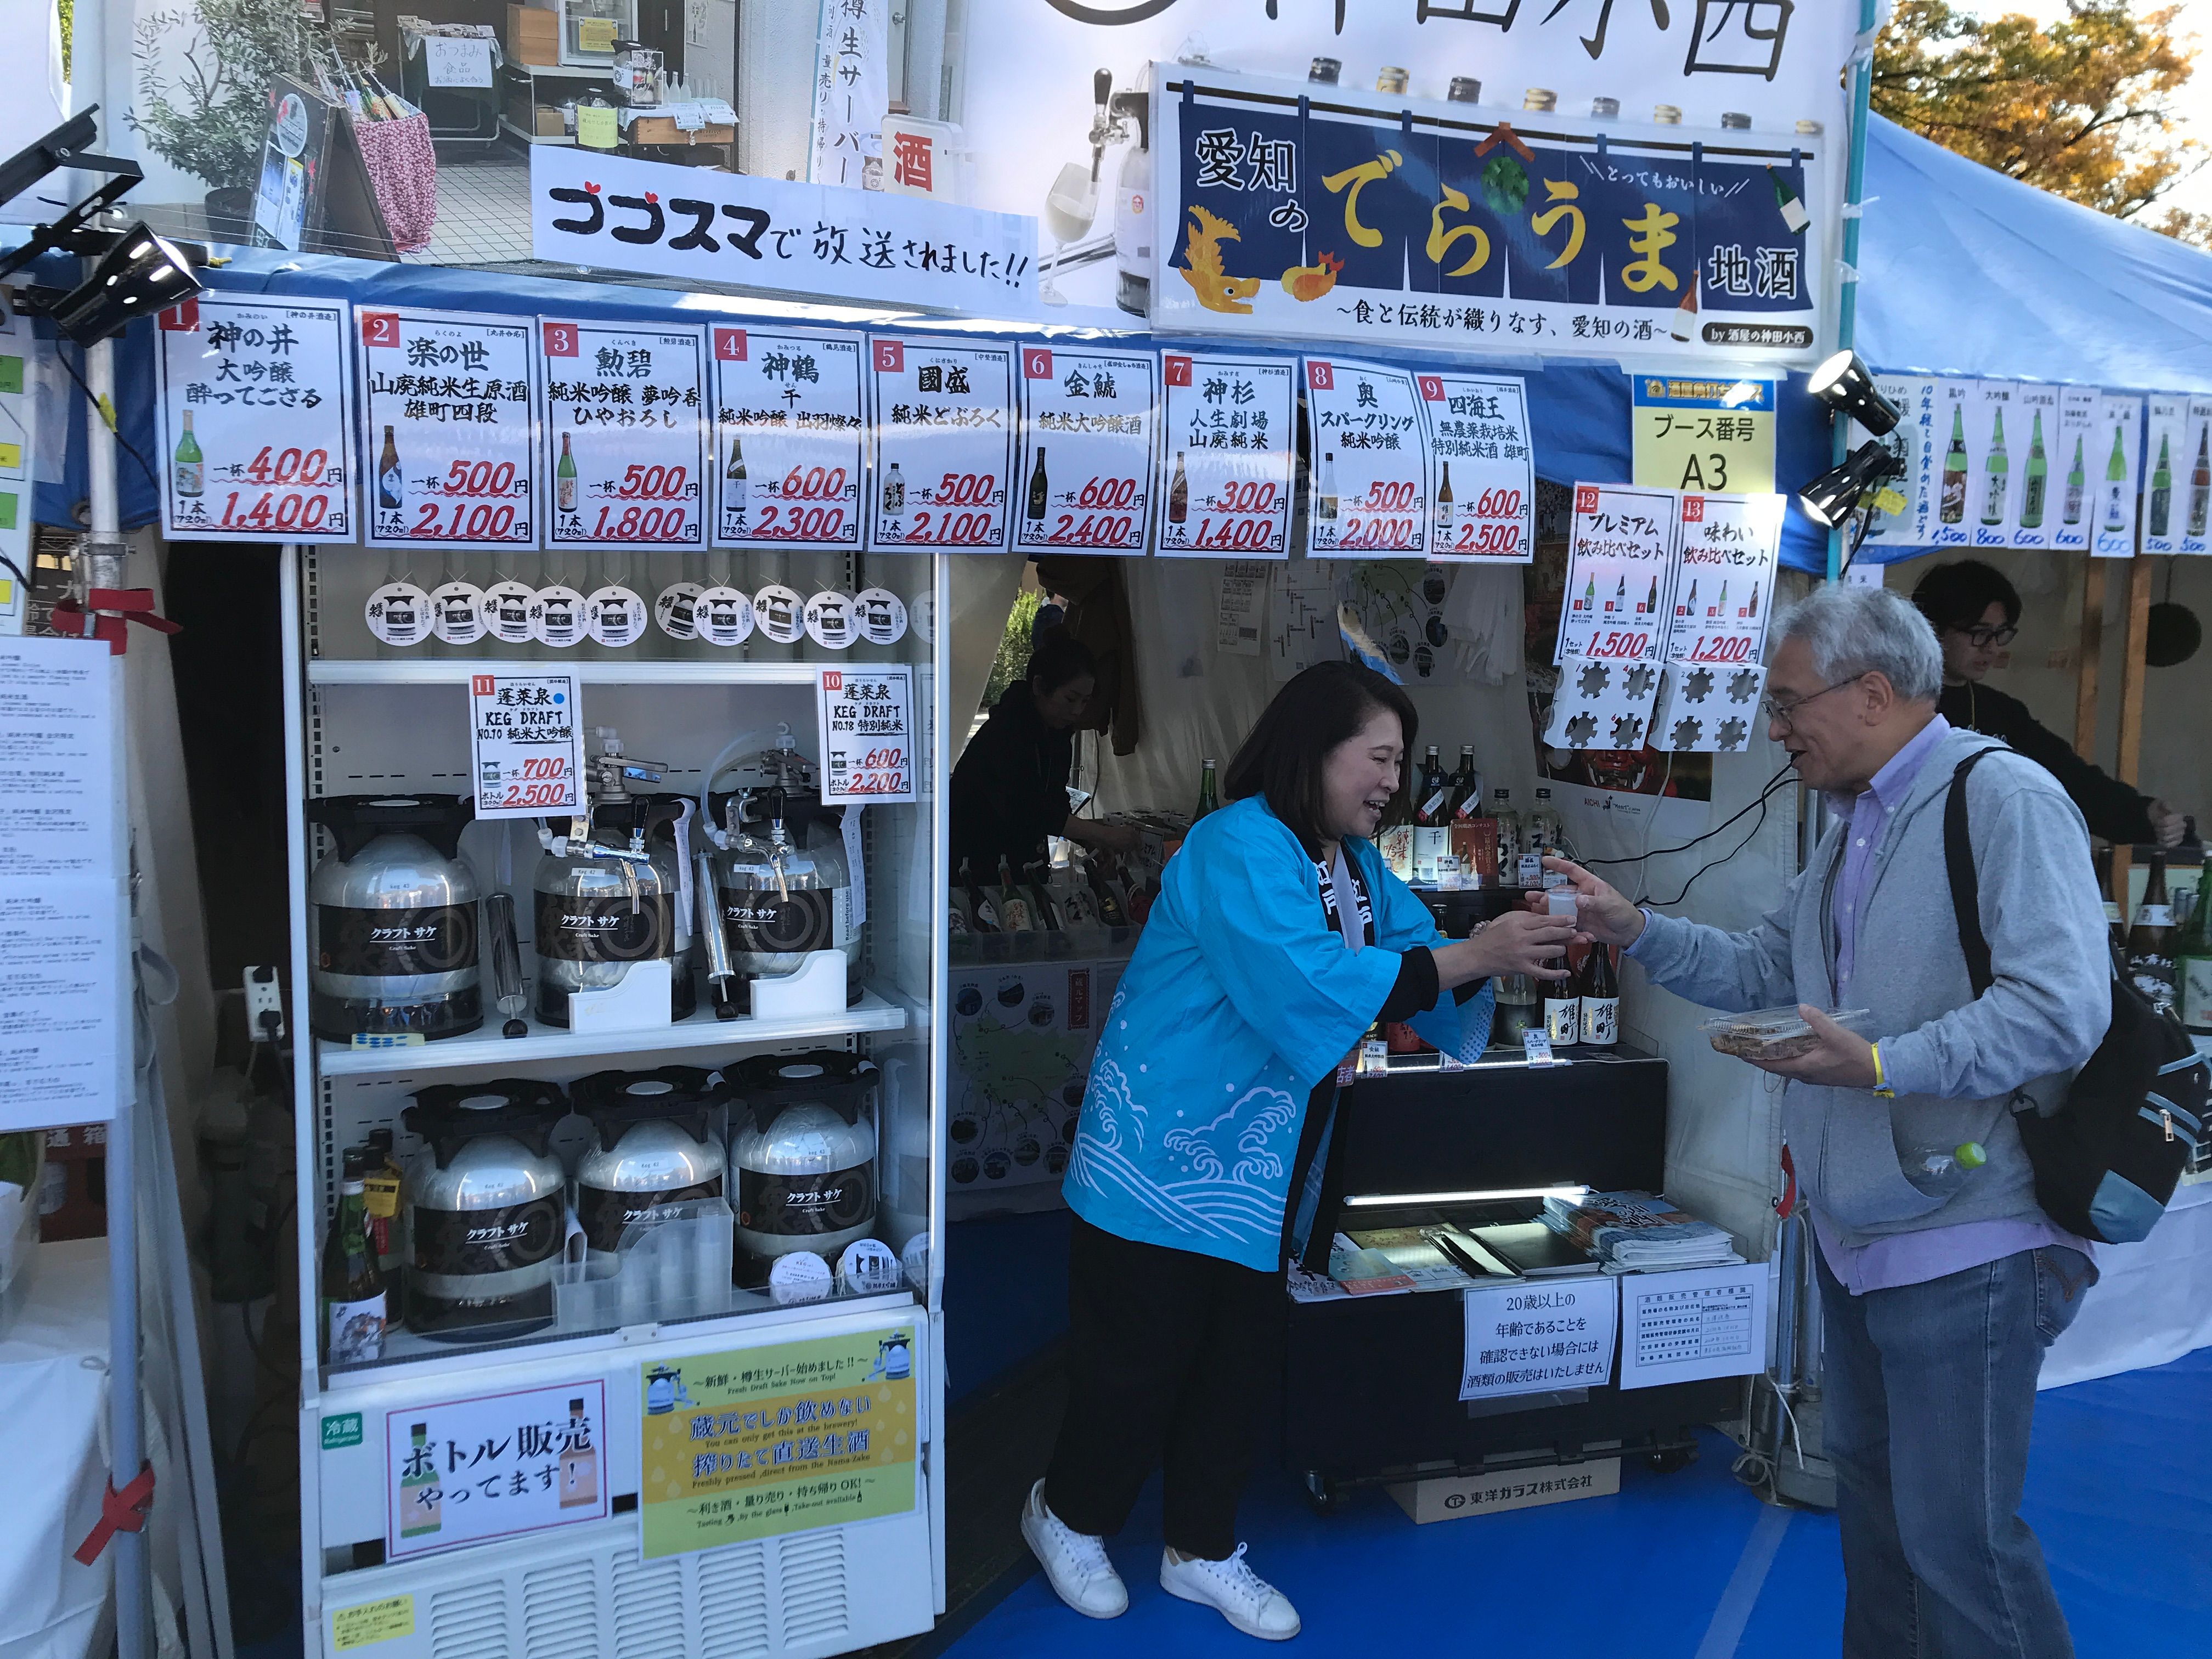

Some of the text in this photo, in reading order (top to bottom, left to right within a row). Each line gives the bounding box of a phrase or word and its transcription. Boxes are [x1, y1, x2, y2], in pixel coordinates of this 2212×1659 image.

[436, 42, 482, 58] おつまみ
[443, 62, 471, 74] 食品
[893, 131, 932, 192] 酒
[1196, 127, 1297, 193] 愛知
[1607, 165, 1724, 196] とってもおいしい
[1322, 149, 1679, 293] でらうま
[1708, 244, 1798, 300] 地酒
[173, 301, 186, 325] 1
[207, 320, 299, 355] 神の井
[373, 318, 390, 341] 2
[554, 329, 569, 352] 3
[1711, 329, 1805, 343] by 酒屋の神田小西
[407, 337, 490, 371] 楽の世
[723, 335, 740, 356] 4
[882, 346, 895, 367] 5
[216, 358, 296, 383] 大吟醸
[595, 346, 652, 379] 勲碧
[761, 352, 820, 383] 神鶴
[1031, 354, 1045, 374] 6
[1173, 362, 1184, 382] 7
[370, 372, 528, 402] 山廃純米生原酒
[918, 366, 970, 394] 國盛
[1064, 369, 1117, 399] 金鯱
[1314, 366, 1327, 386] 8
[186, 383, 322, 409] 酔ってござる
[548, 381, 702, 408] 純米吟醸 夢吟香
[781, 388, 801, 409] 千
[1203, 378, 1256, 405] 神杉
[1356, 381, 1378, 408] 奥
[1426, 381, 1438, 398] 9
[404, 398, 498, 424] 雄町四段
[573, 407, 677, 429] ひやおろし
[891, 403, 1001, 428] 純米どぶろく
[1448, 394, 1505, 420] 四海王
[718, 408, 862, 432] 純米吟醸 出羽燦々
[1039, 411, 1142, 435] 純米大吟醸酒
[1189, 409, 1269, 430] 人生劇場
[1321, 411, 1414, 431] スパークリング
[1439, 420, 1518, 441] 無農薬栽培米
[1655, 414, 1754, 442] ブース番号
[1189, 429, 1269, 450] 山廃純米
[1340, 432, 1402, 450] 純米吟醸
[1431, 438, 1530, 461] 特別純米酒 雄町
[1680, 453, 1727, 490] A3
[178, 492, 344, 528] 1本 1,400円
[1579, 492, 1595, 509] 12
[1686, 501, 1701, 517] 13
[380, 503, 528, 537] 1本 2,100円
[560, 506, 698, 538] 1本 1,800円
[752, 506, 855, 537] 2,300円
[906, 512, 1001, 541] 2,100円
[1048, 515, 1141, 543] 2,400円
[1588, 513, 1659, 536] プレミアム
[1704, 521, 1754, 542] 味わい
[1195, 518, 1282, 547] 1,400円
[1339, 518, 1422, 546] 2,000円
[1454, 523, 1527, 551] 2,500円
[1977, 529, 2005, 545] 800
[2013, 529, 2044, 545] 600
[2056, 528, 2084, 545] 600
[2097, 533, 2130, 553] 600
[1577, 537, 1664, 561] 飲み比べセット
[2146, 537, 2172, 551] 500
[1683, 546, 1768, 566] 飲み比べセット
[1587, 631, 1654, 657] 1,500円
[1691, 636, 1757, 660] 1,200円
[475, 679, 492, 693] 11
[825, 675, 840, 688] 10
[843, 684, 891, 701] 蓬莱泉
[496, 687, 552, 706] 蓬莱泉
[486, 711, 563, 726] KEG DRAFT
[834, 706, 900, 718] KEG DRAFT
[507, 726, 573, 740] 純米大吟醸
[832, 719, 903, 732] NO.18 特別純米
[848, 772, 909, 792] 2,200円
[481, 783, 574, 805] ボトル 2,500円
[1584, 798, 1600, 807] AICHI
[1428, 831, 1441, 845] 千
[561, 915, 620, 928] クラフト サケ
[727, 906, 777, 919] クラフト サケ
[371, 926, 437, 939] クラフト サケ
[1558, 1003, 1577, 1041] 雄町
[1594, 1003, 1613, 1040] 雄町
[786, 1188, 843, 1204] クラフト サケ
[1506, 1292, 1576, 1311] 20歳以上の
[1496, 1317, 1587, 1338] 年齢であることを
[1480, 1340, 1599, 1364] 確認できない場合には
[1467, 1362, 1604, 1389] 酒類の販売はいたしません
[326, 1418, 358, 1436] 冷蔵
[690, 1396, 871, 1441] 蔵元でしか飲めない
[402, 1415, 592, 1478] ボトル販売
[693, 1429, 870, 1479] 搾りたて直送生酒
[416, 1463, 576, 1510] やってます!
[1470, 1475, 1593, 1505] 東洋ガラス株式会社
